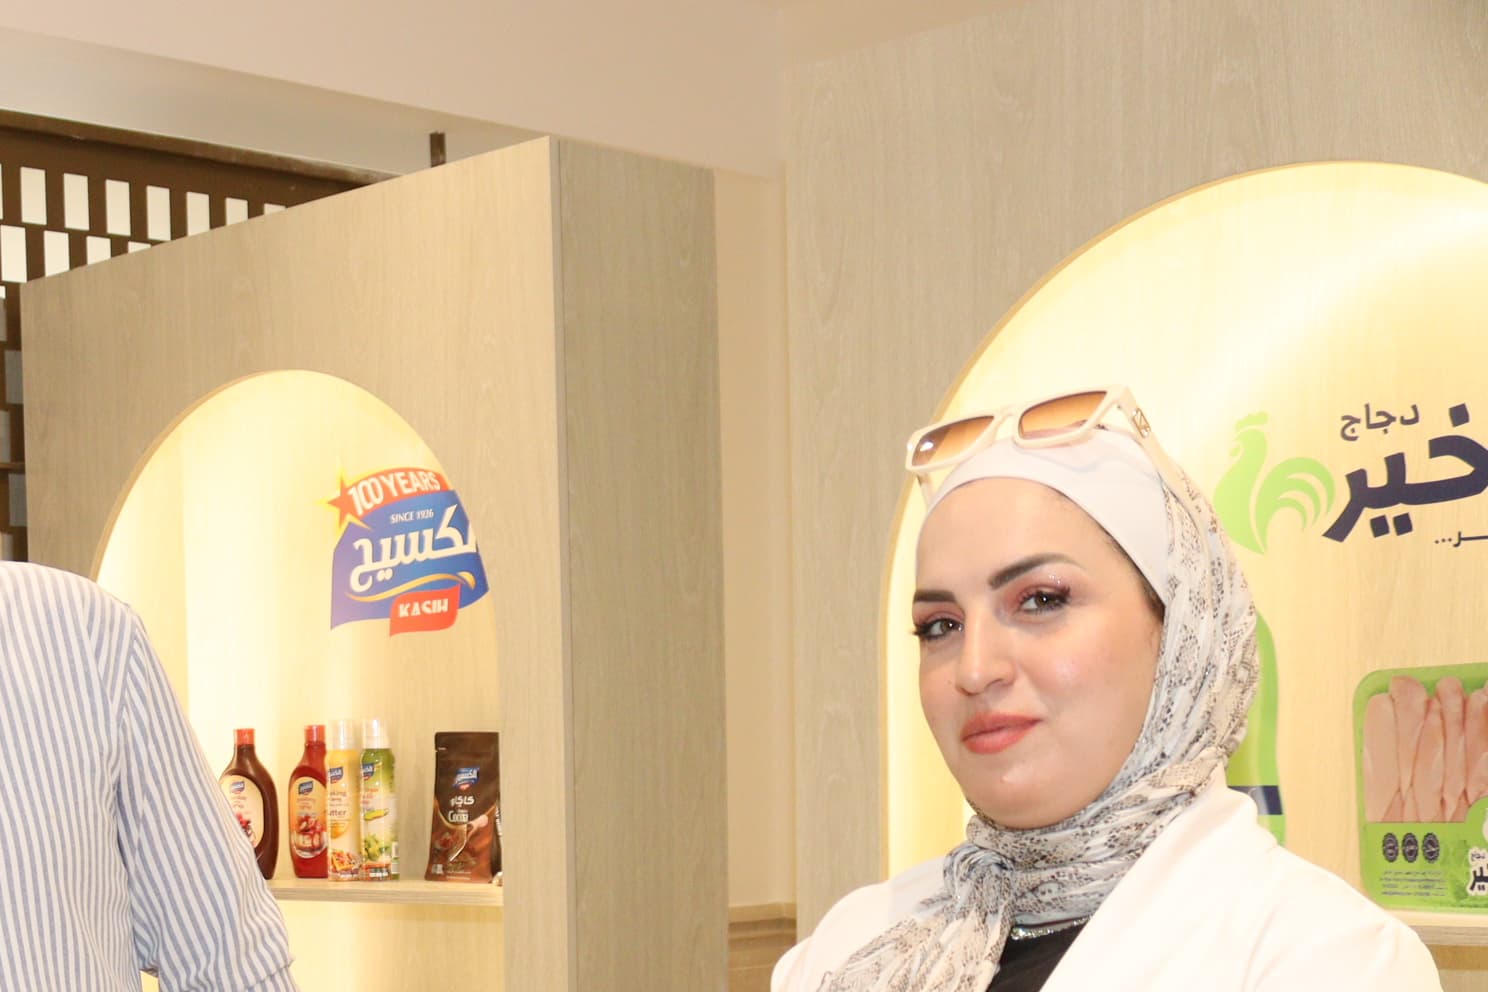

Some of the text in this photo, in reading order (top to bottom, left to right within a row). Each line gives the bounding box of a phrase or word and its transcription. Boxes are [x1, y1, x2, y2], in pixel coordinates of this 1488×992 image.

[1340, 403, 1419, 442] دجاج
[380, 471, 441, 497] YEARS
[1322, 403, 1488, 543] خير
[389, 511, 415, 524] SINCE
[399, 598, 449, 618] KASIH
